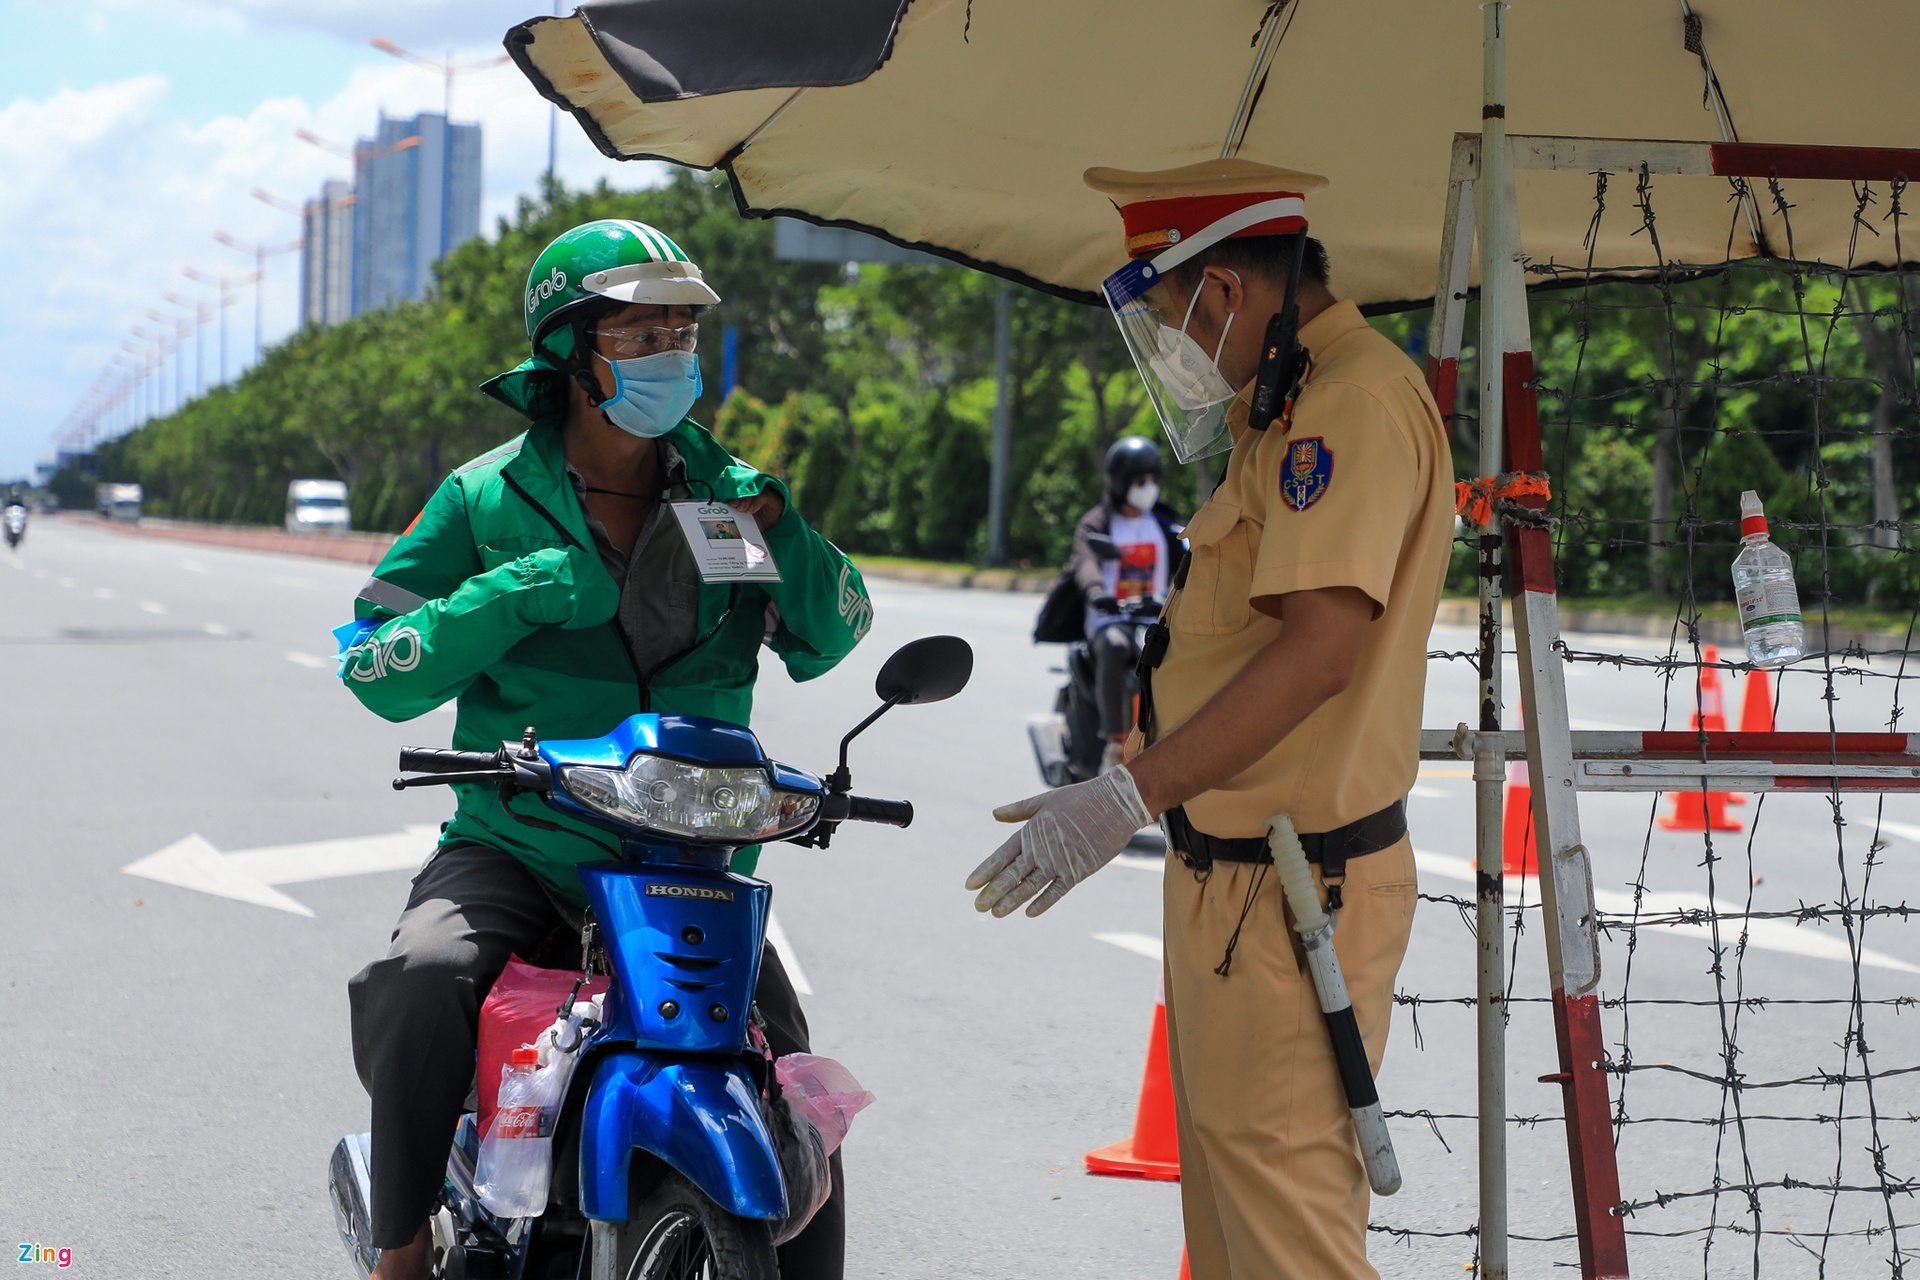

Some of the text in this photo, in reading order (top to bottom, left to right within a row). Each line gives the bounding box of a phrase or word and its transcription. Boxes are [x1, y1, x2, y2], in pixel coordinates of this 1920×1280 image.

[527, 266, 567, 314] Grab
[1283, 473, 1325, 490] CSGT
[697, 506, 729, 515] Grab
[838, 562, 874, 642] Gra
[650, 885, 729, 900] HONDA
